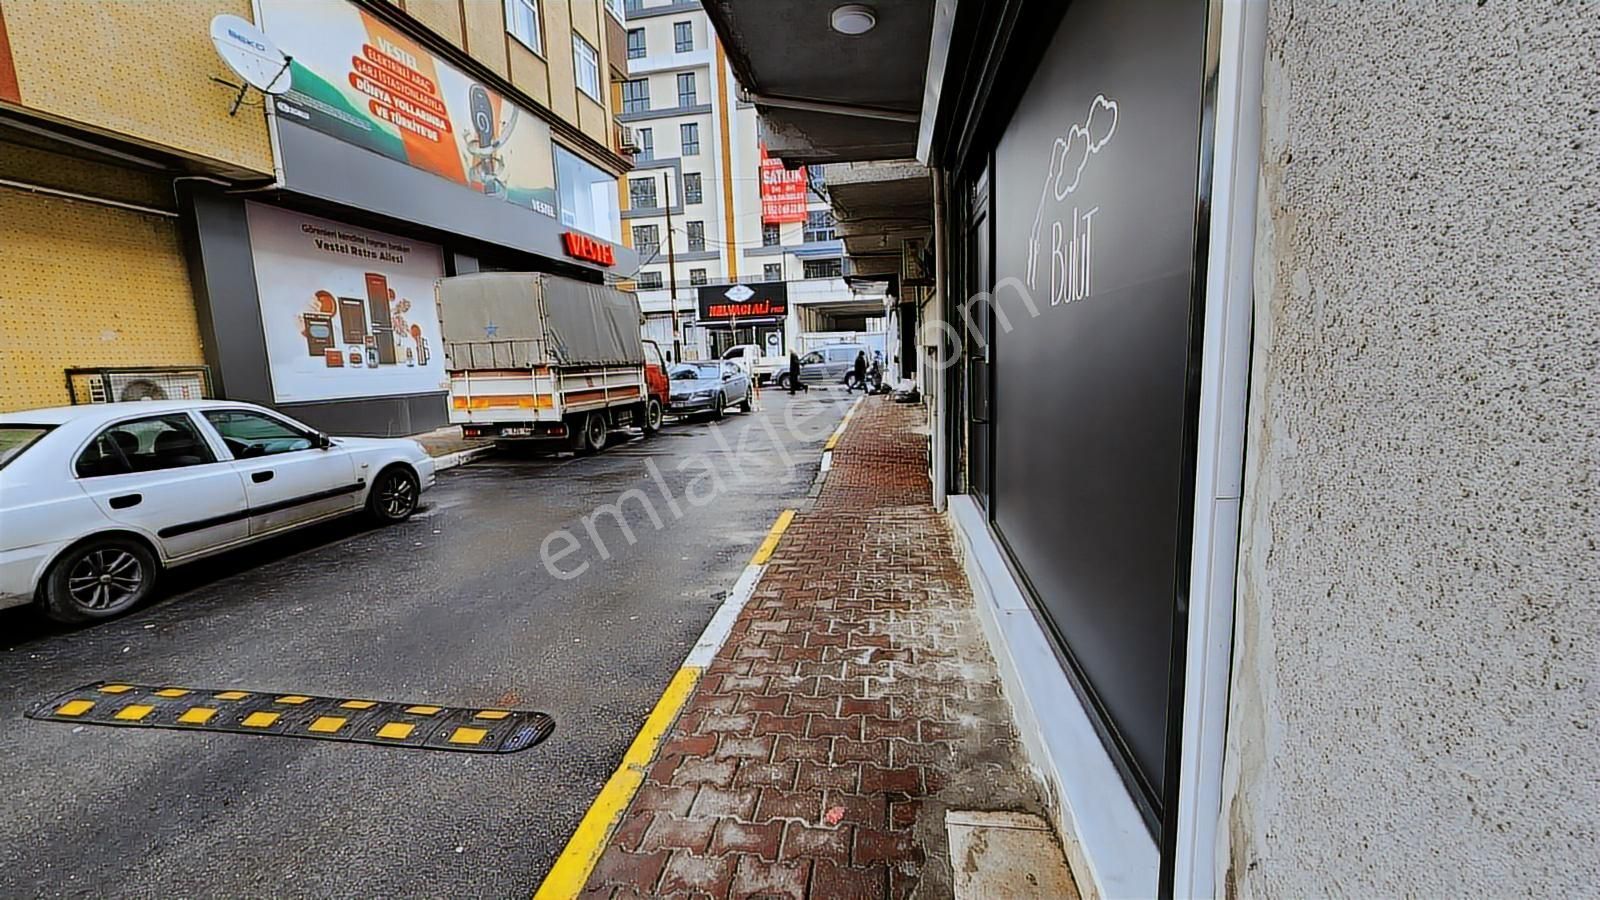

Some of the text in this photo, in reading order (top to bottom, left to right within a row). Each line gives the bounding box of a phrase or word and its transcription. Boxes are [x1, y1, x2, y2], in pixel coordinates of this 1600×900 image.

[377, 35, 417, 71] VESTEL
[531, 198, 556, 218] VESTEL
[562, 230, 616, 267] VESTEL
